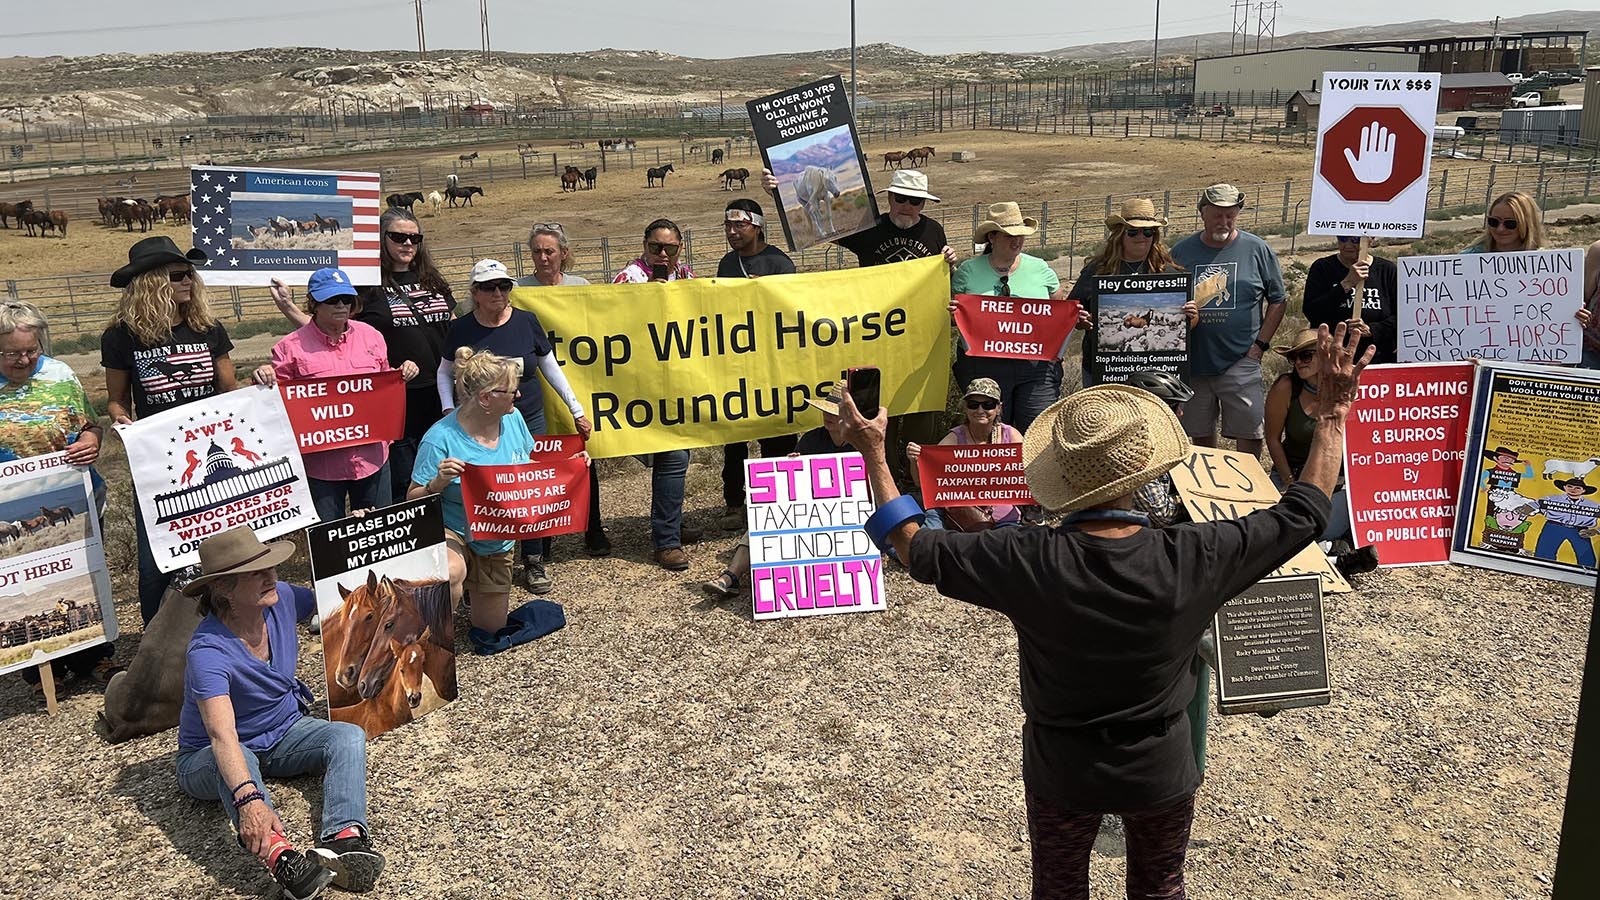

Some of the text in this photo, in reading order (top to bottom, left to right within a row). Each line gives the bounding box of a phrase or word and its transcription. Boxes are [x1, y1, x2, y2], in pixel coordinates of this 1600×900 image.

[1329, 78, 1432, 91] YOUR TAX $$$
[755, 83, 836, 113] I'M OVER 30 YRS
[765, 94, 832, 121] OLD. I WON'T
[776, 107, 829, 129] SURVIVE A
[780, 117, 829, 138] ROUNDUP
[254, 176, 329, 187] American Icons
[1315, 220, 1418, 231] SAVE THE WILD HORSES
[253, 256, 332, 265] Leave them Wild
[1402, 251, 1573, 277] WHITE MOUNTAIN
[1098, 277, 1187, 292] Hey Congress!!!
[1405, 281, 1454, 304] HMA
[1465, 278, 1508, 300] HAS
[1518, 276, 1569, 297] >300
[980, 300, 1052, 316] FREE OUR
[1415, 302, 1553, 327] CATTLE FOR
[997, 321, 1033, 335] WILD
[1403, 322, 1577, 348] EVERY 1 HORSE
[547, 307, 907, 377] top Wild Horse
[984, 340, 1043, 355] HORSES!
[133, 343, 209, 360] BORN FREE
[1095, 354, 1188, 364] Stop Prioritizing Commercial
[1414, 347, 1568, 362] ON PUBLIC LAND
[1105, 364, 1135, 372] Livestock
[1162, 364, 1178, 372] Over
[146, 385, 214, 404] STAY WILD
[286, 378, 373, 400] FREE OUR
[1395, 381, 1468, 397] BLAMING
[1508, 379, 1533, 387] DON'T
[1549, 383, 1572, 391] THEM
[1574, 386, 1594, 394] PULL
[1510, 387, 1535, 395] WOOL
[1536, 389, 1558, 397] OVER
[1559, 392, 1583, 400] YOUR
[311, 403, 354, 421] WILD
[1357, 405, 1459, 423] WILD HORSES
[300, 424, 370, 447] HORSES!
[1371, 427, 1445, 444] & BURROS
[533, 440, 562, 452] OUR
[953, 448, 1017, 458] WILD HORSE
[39, 455, 70, 469] HER
[1351, 449, 1465, 466] For Damage Done
[495, 468, 556, 484] WILD HORSE
[944, 462, 1024, 473] ROUNDUPS ARE
[1182, 452, 1254, 493] YES
[1403, 468, 1420, 483] By
[748, 456, 867, 504] STOP
[936, 477, 987, 487] TAXPAYER
[1491, 474, 1518, 482] RANCHER
[486, 484, 566, 502] ROUNDUPS ARE
[935, 490, 1032, 501] ANIMAL CRUELTY!!!
[1373, 488, 1451, 503] COMMERCIAL
[168, 485, 293, 532] ADVOCATES FOR
[473, 500, 571, 519] TAXPAYER FUNDED
[749, 500, 874, 530] TAXPAYER
[1356, 505, 1456, 523] LIVESTOCK GRAZI
[1543, 500, 1571, 508] BUREAU
[1580, 505, 1600, 513] LAND
[1547, 505, 1595, 517] MANAGEMENT
[177, 498, 290, 541] WILD EQUINES
[327, 505, 426, 541] PLEASE DON'T
[470, 515, 571, 534] ANIMAL CRUELTY!!!
[348, 524, 413, 552] DESTROY
[1366, 526, 1452, 543] On PUBLIC Lan
[1489, 533, 1519, 542] AMERICAN
[1489, 538, 1517, 546] TAXPAYER
[346, 538, 418, 569] MY FAMILY
[762, 530, 870, 562] FUNDED
[23, 557, 73, 581] HERE
[752, 559, 881, 614] CRUELTY
[1244, 597, 1263, 605] Lands
[1263, 596, 1276, 604] Day
[1276, 594, 1298, 603] Project
[1298, 592, 1314, 600] 2006
